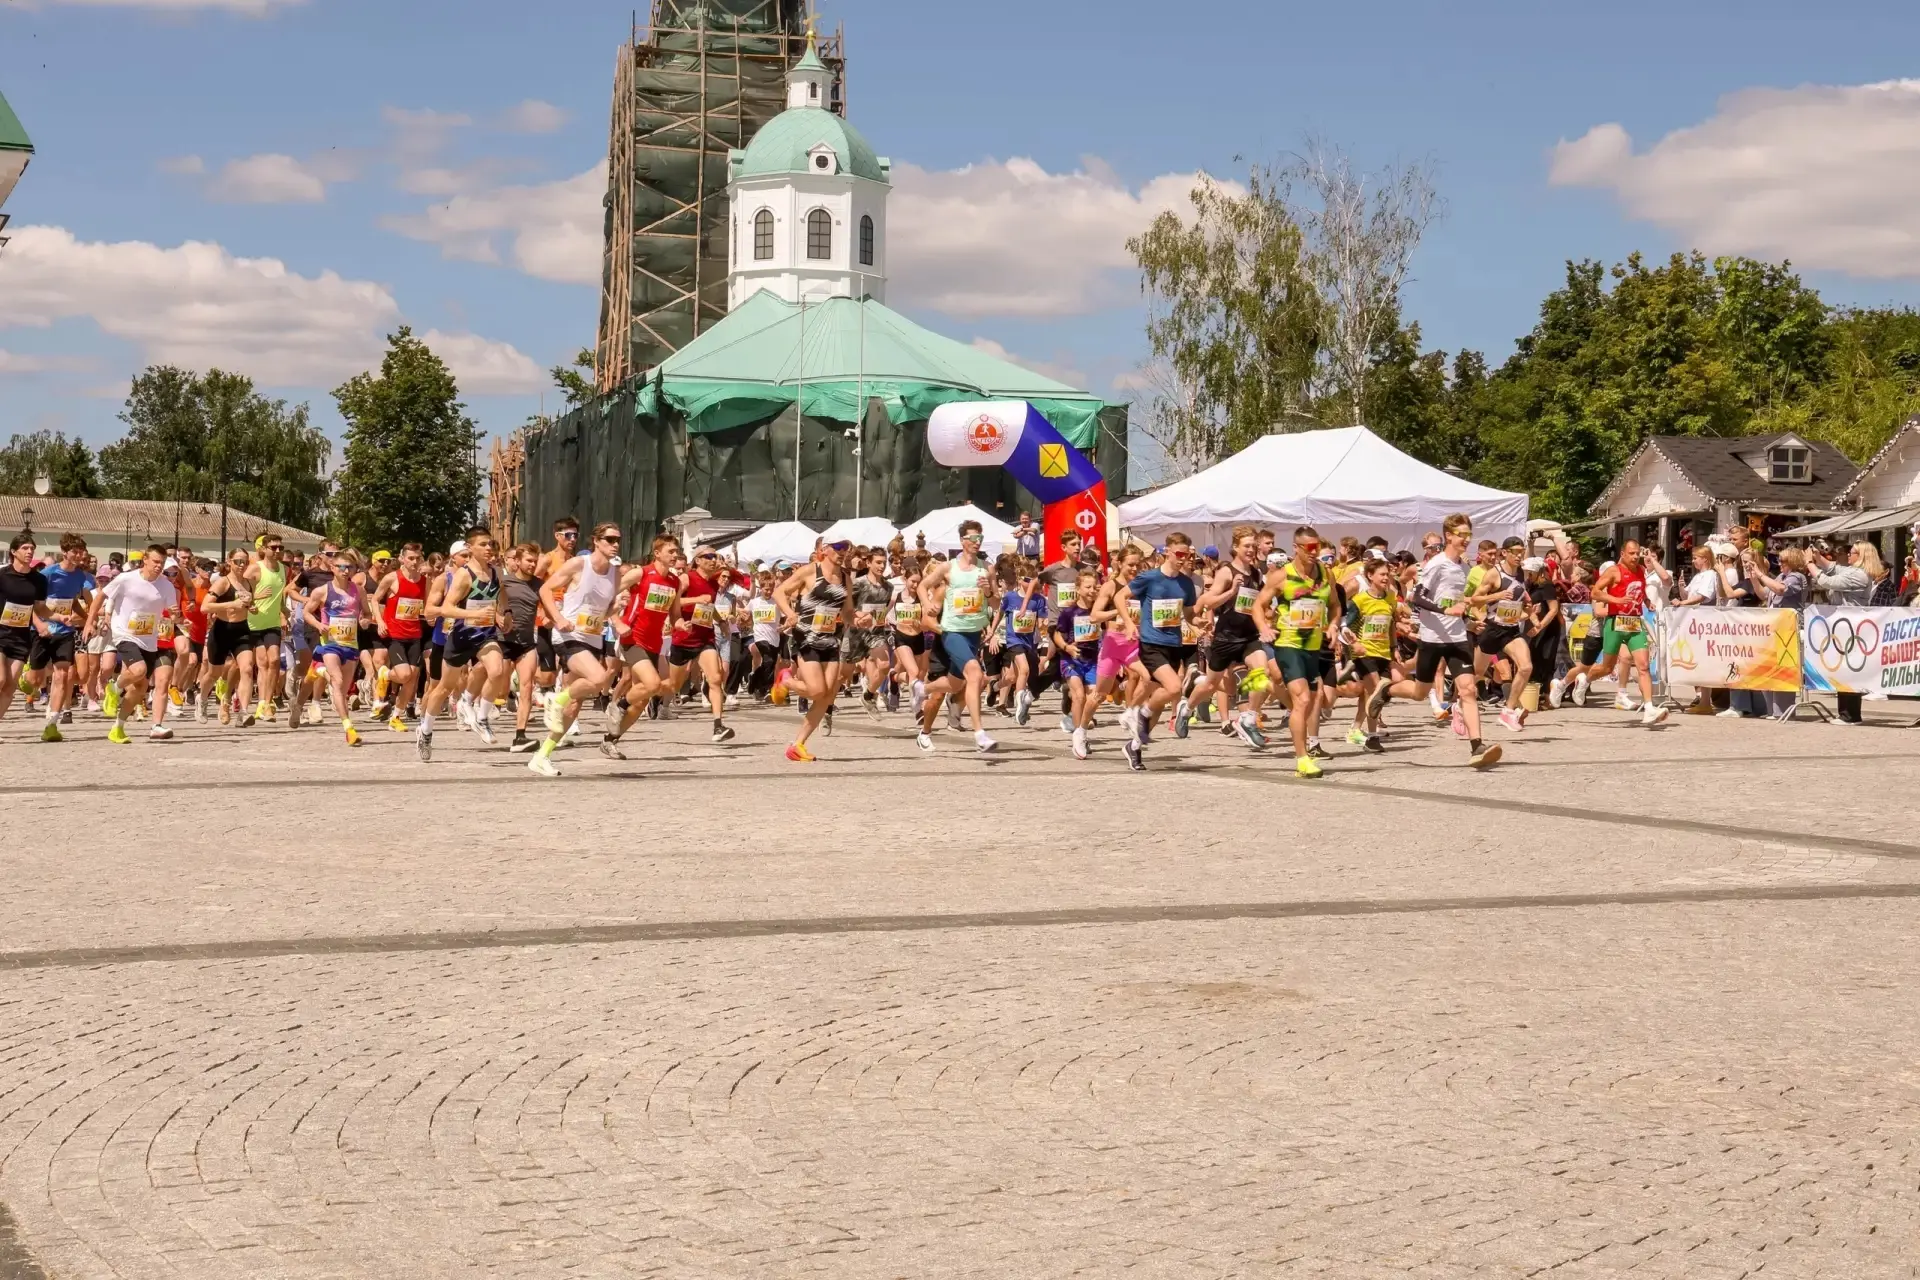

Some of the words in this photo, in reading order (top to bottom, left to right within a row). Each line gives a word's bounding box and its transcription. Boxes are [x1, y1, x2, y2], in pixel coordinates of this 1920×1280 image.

[1301, 610, 1313, 620] 19
[1504, 609, 1517, 617] 60
[137, 620, 147, 630] 21
[586, 616, 601, 627] 66
[337, 625, 352, 635] 50
[1689, 618, 1771, 640] Арзамасские
[1707, 640, 1754, 661] Купола
